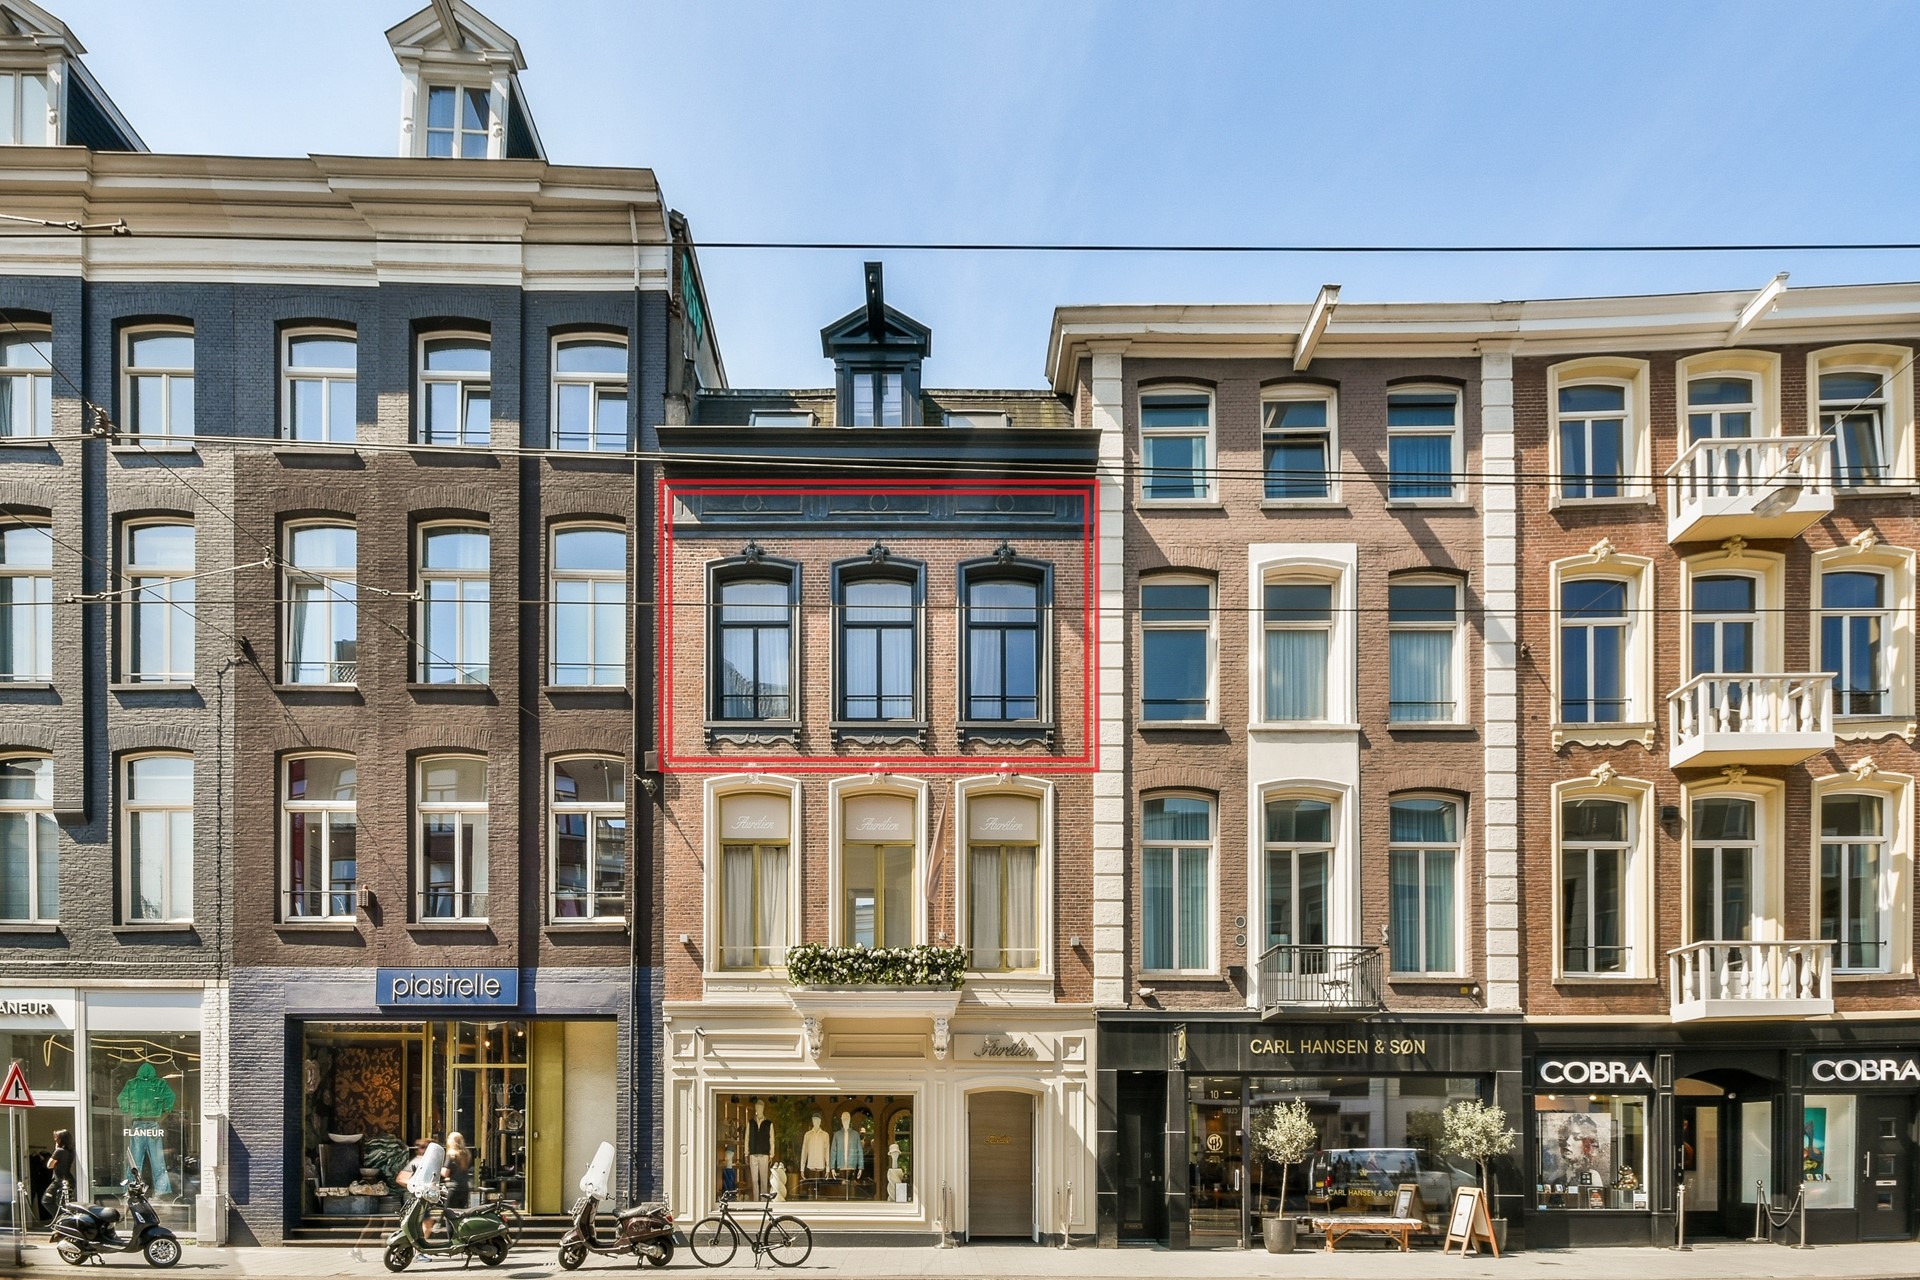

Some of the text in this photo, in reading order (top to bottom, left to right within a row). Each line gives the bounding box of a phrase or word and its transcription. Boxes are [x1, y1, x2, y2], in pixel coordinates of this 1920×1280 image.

[392, 973, 500, 1001] piastrelle
[1250, 1039, 1426, 1055] CARL HANSEN & SØN
[1541, 1061, 1653, 1084] COBRA
[1812, 1059, 1920, 1082] COBRA
[1210, 1090, 1219, 1099] 10
